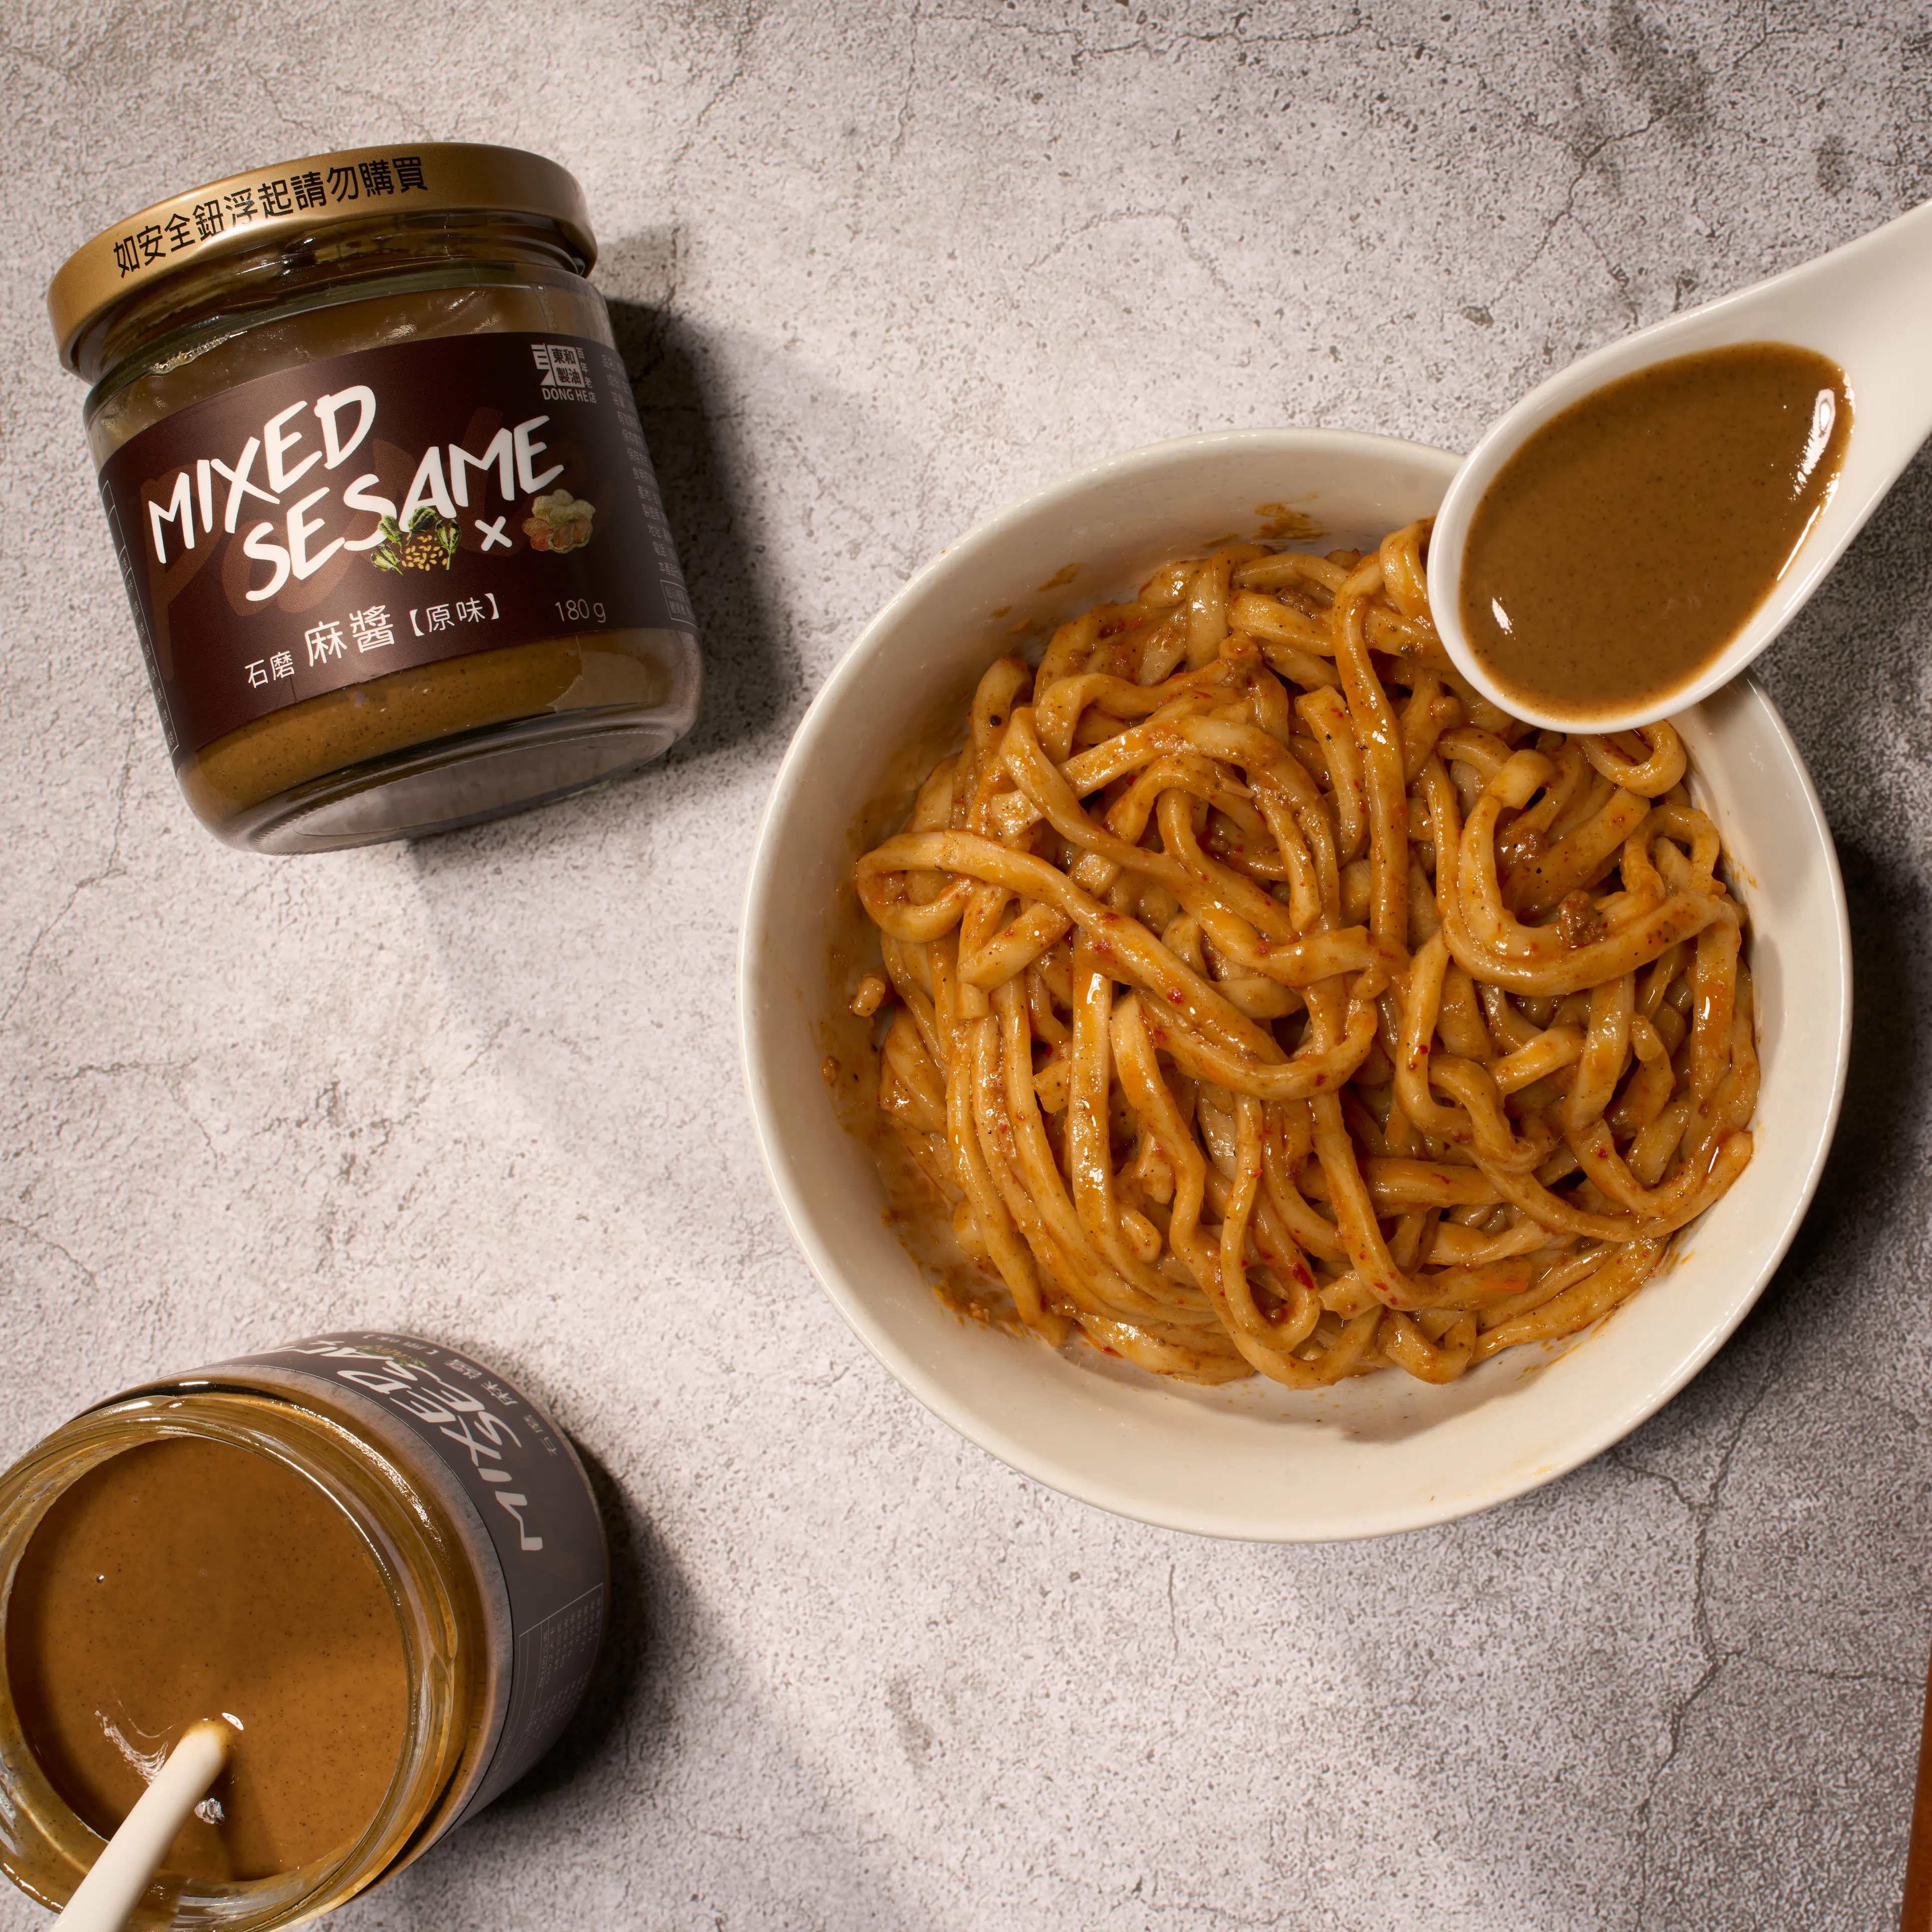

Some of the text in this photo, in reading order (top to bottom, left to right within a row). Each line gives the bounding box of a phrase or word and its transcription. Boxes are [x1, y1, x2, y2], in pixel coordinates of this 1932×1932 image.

[114, 156, 428, 279] 如安全鈕浮起請勿購買
[542, 387, 590, 402] DONG HE
[551, 348, 577, 365] 東和
[149, 385, 377, 564] MIXED
[243, 414, 565, 602] SESAME
[245, 651, 295, 688] 石磨
[304, 605, 395, 667] 麻醬
[556, 599, 606, 623] 180 g
[337, 1370, 544, 1551] MIXED
